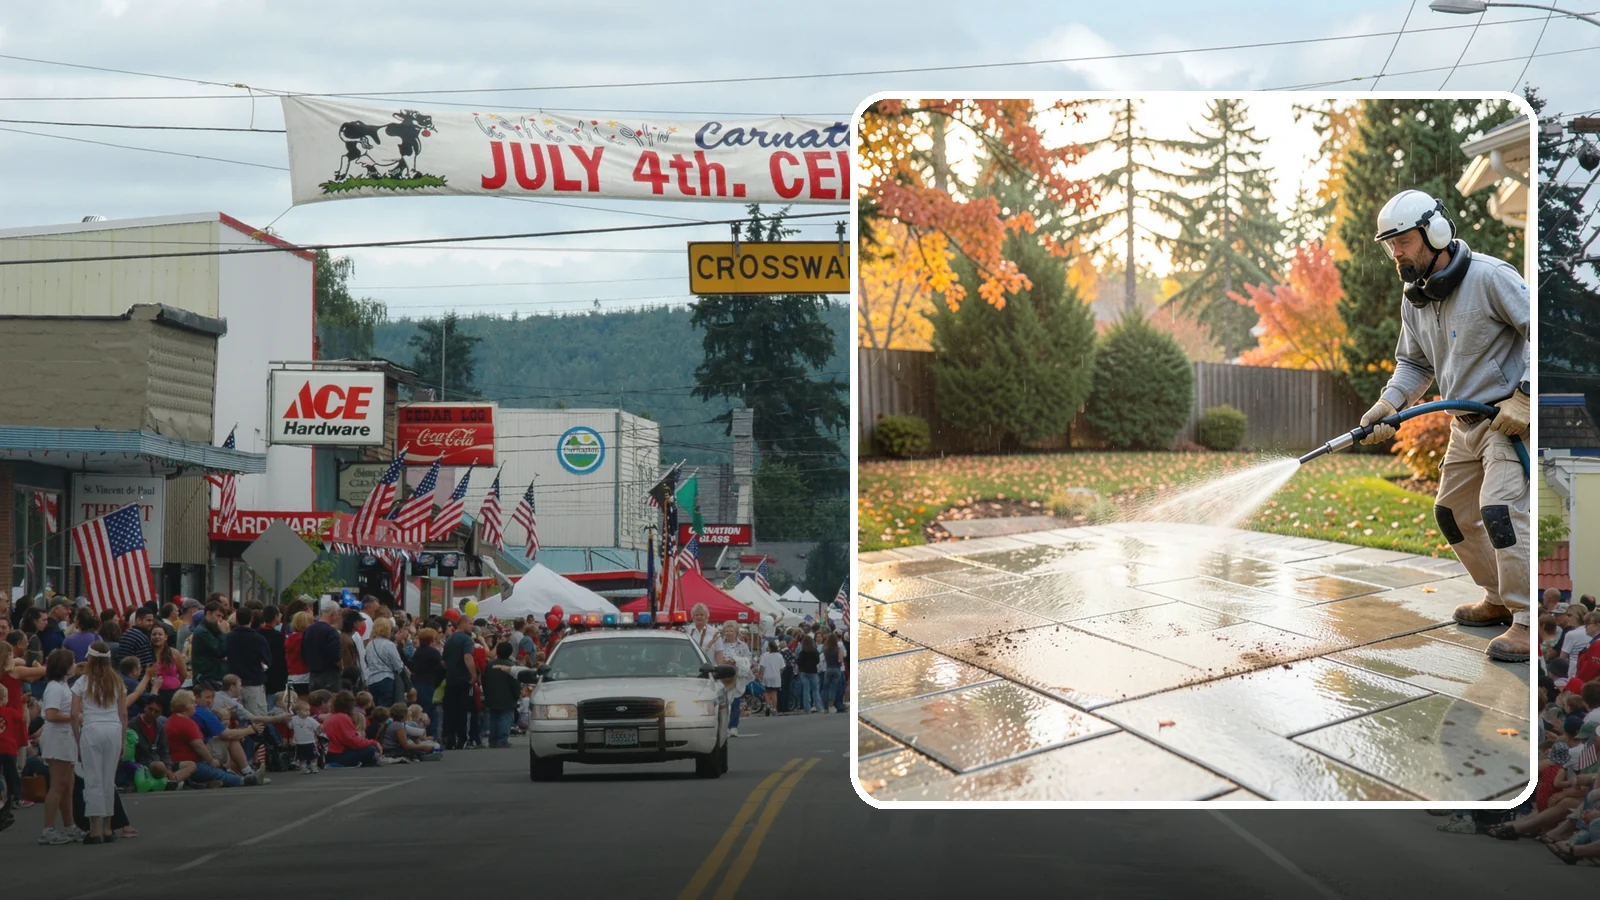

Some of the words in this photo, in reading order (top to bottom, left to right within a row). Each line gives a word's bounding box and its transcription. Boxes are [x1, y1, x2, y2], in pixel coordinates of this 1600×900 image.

[481, 141, 604, 192] JULY
[632, 150, 746, 197] 4th.
[696, 254, 850, 280] CROSSWA
[283, 380, 373, 419] ACE
[405, 409, 453, 422] CEDAR
[461, 409, 485, 422] LOG
[283, 421, 371, 436] Hardware
[416, 428, 477, 447] Coca-Cola
[353, 467, 385, 480] Simpl
[95, 485, 124, 495] Vincent
[126, 486, 136, 495] de
[137, 486, 155, 495] Paul
[688, 526, 741, 535] CRNATION
[699, 535, 730, 543] GLASS
